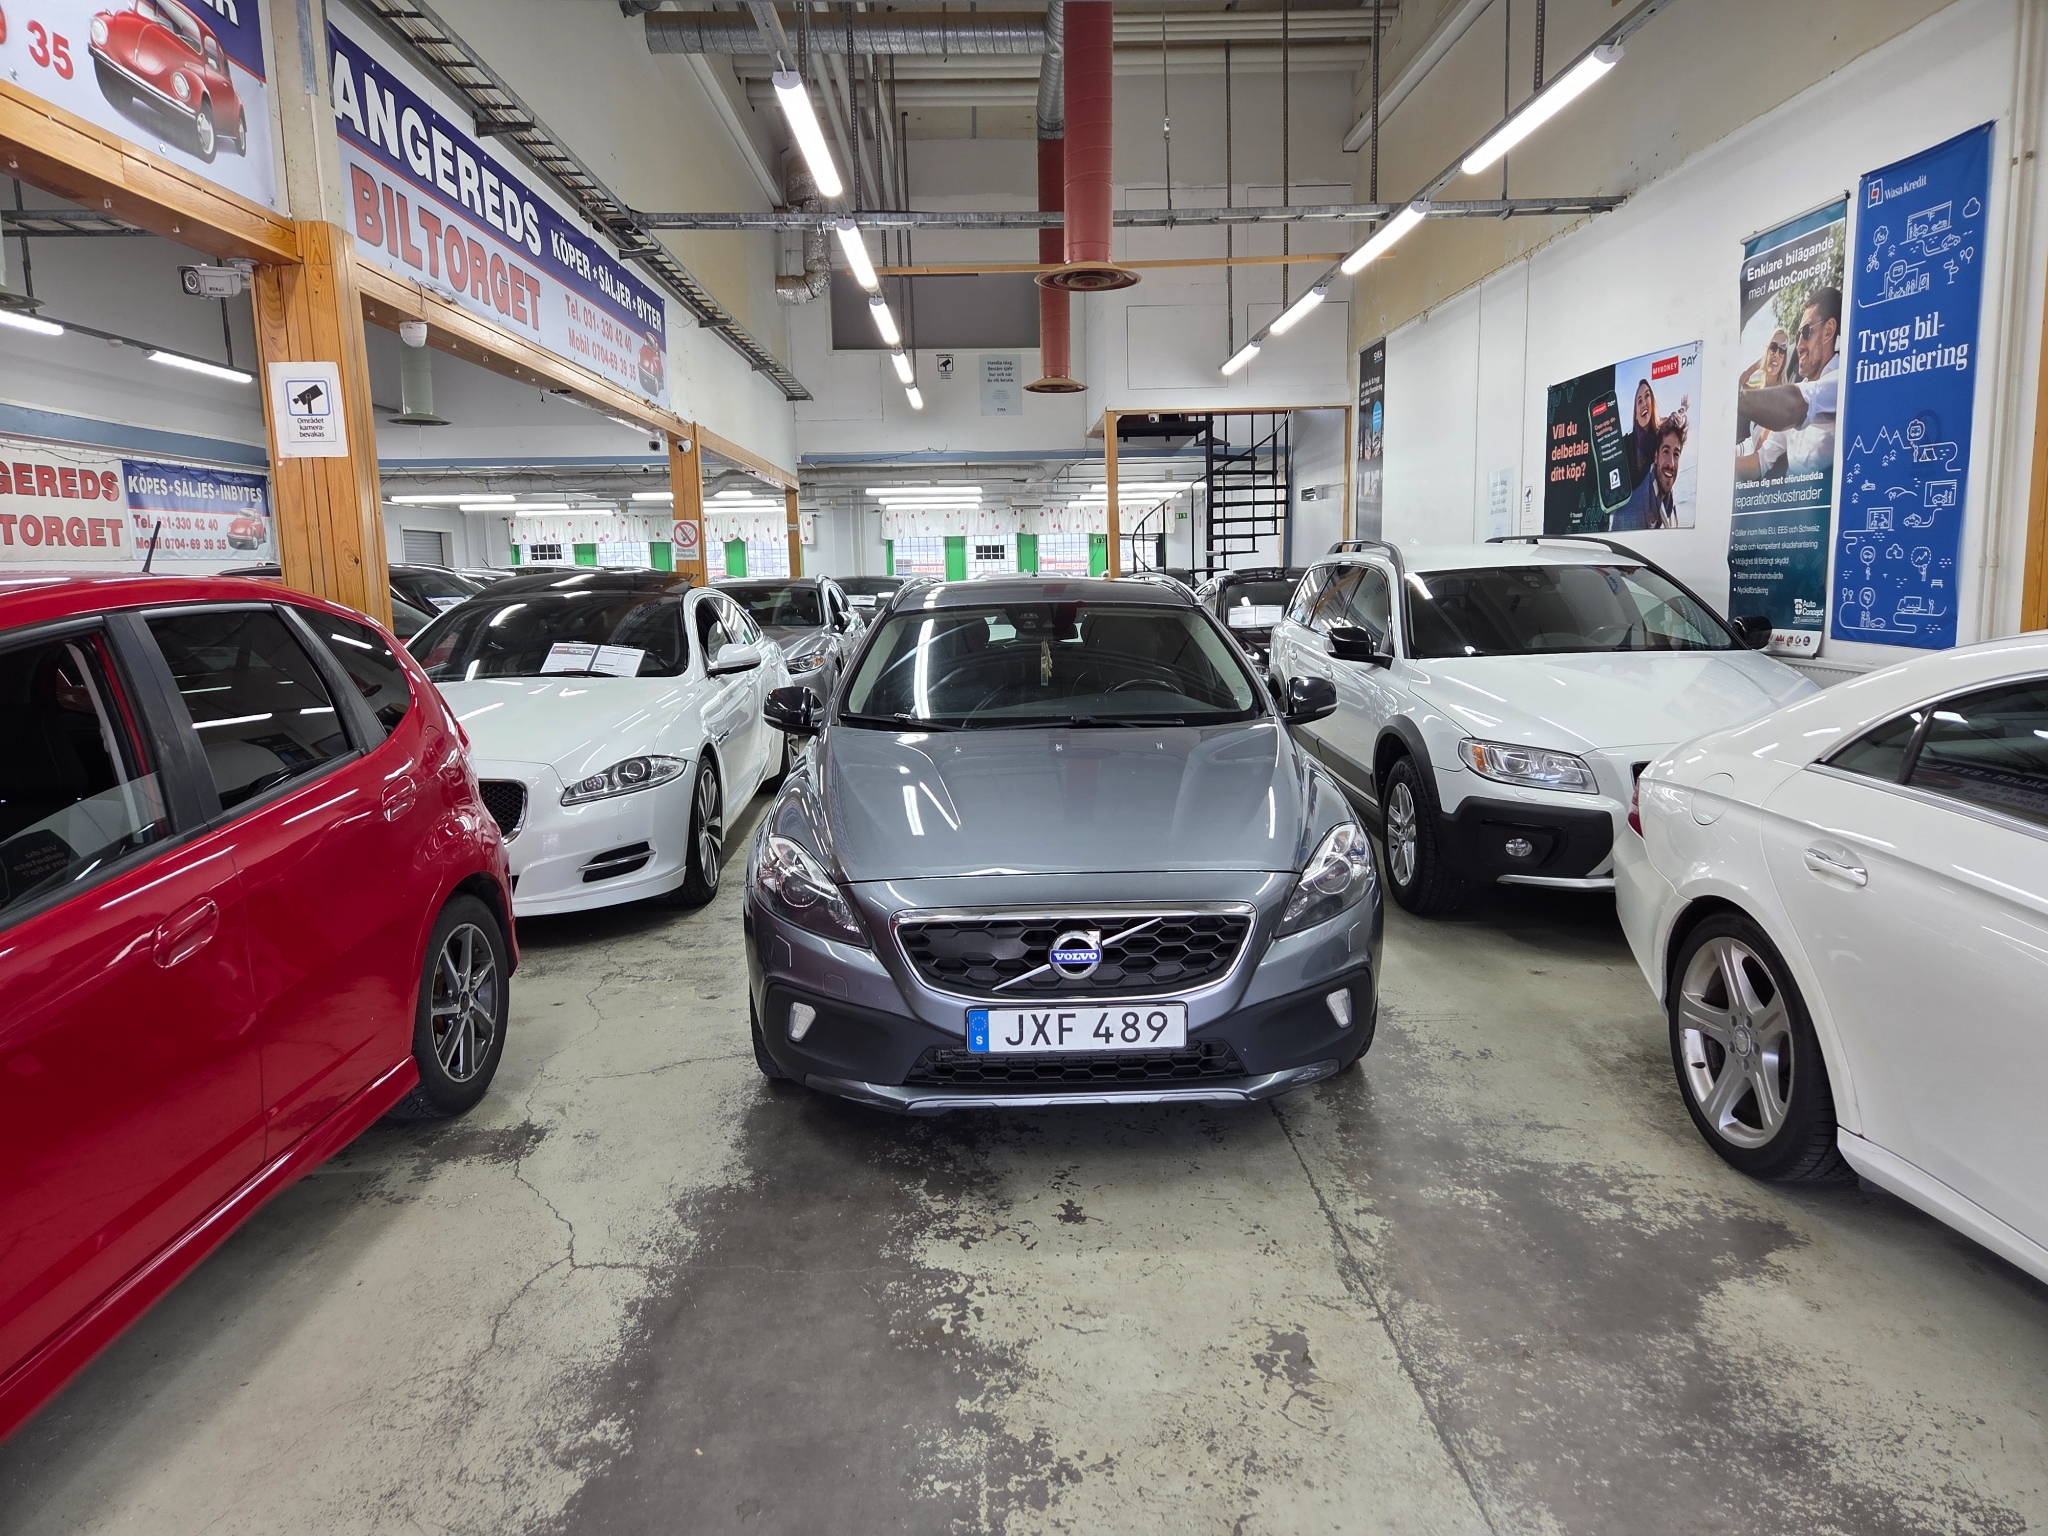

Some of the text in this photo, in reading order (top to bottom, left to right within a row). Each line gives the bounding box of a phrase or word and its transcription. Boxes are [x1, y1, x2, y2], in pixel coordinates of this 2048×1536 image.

[27, 19, 73, 80] 35
[333, 49, 542, 257] ANGEREDS
[1885, 174, 1927, 200] Wasa Kredit
[350, 162, 540, 331] BILTORGET
[1747, 236, 1834, 281] Enklare bilägande
[550, 228, 662, 333] KÖPER SÄLJER BYTER
[1748, 257, 1832, 300] med AutoConcept
[564, 294, 581, 322] Tel.
[601, 318, 613, 343] 330
[616, 327, 623, 348] 42
[624, 334, 632, 354] 40
[1858, 311, 1946, 356] Trygg bil-
[568, 327, 590, 356] Mobil
[1682, 354, 1698, 368] PAY
[1855, 343, 1969, 384] finansiering
[1552, 423, 1565, 440] Vill
[1567, 421, 1578, 436] du
[1552, 440, 1588, 460] delbetala
[1551, 461, 1586, 482] ditt köp?
[1736, 470, 1824, 490] Försäkra dig mot oförutsedda
[128, 473, 262, 503] KÖPES SÄLJES INBYTES
[1735, 486, 1822, 509] reparationskostnader
[0, 514, 123, 547] TORGET
[133, 514, 153, 529] Tel.
[195, 518, 206, 530] 42
[208, 519, 218, 531] 40
[1768, 527, 1776, 535] EU,
[1799, 524, 1820, 532] Schweiz
[165, 538, 201, 550] 0704-69
[204, 539, 214, 550] 39
[217, 539, 226, 550] 35
[1802, 608, 1824, 617] Concept
[1054, 951, 1097, 960] VOLVO
[976, 1036, 983, 1045] S
[1005, 1011, 1168, 1046] JXF 489
